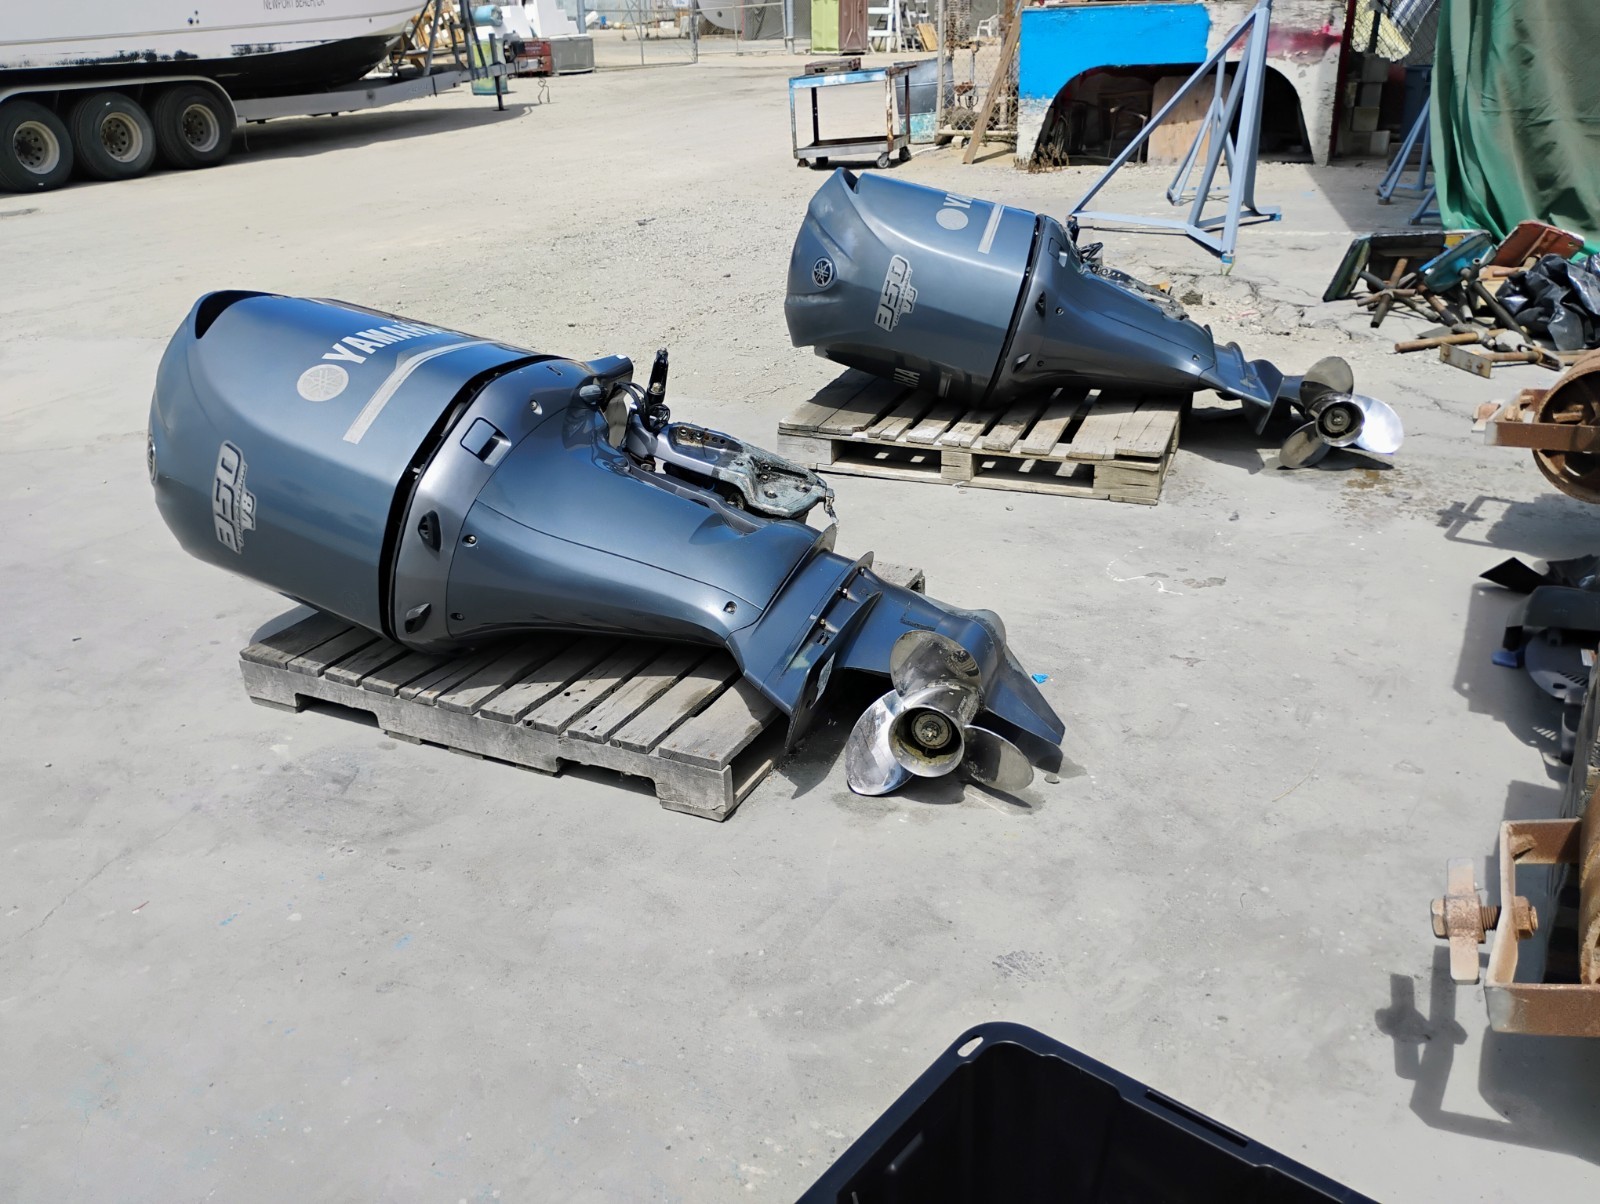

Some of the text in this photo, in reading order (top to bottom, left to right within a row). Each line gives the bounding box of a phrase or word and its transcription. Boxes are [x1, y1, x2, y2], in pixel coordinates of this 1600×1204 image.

[874, 254, 910, 332] 350
[212, 440, 242, 554] 350
[240, 488, 257, 532] V8
